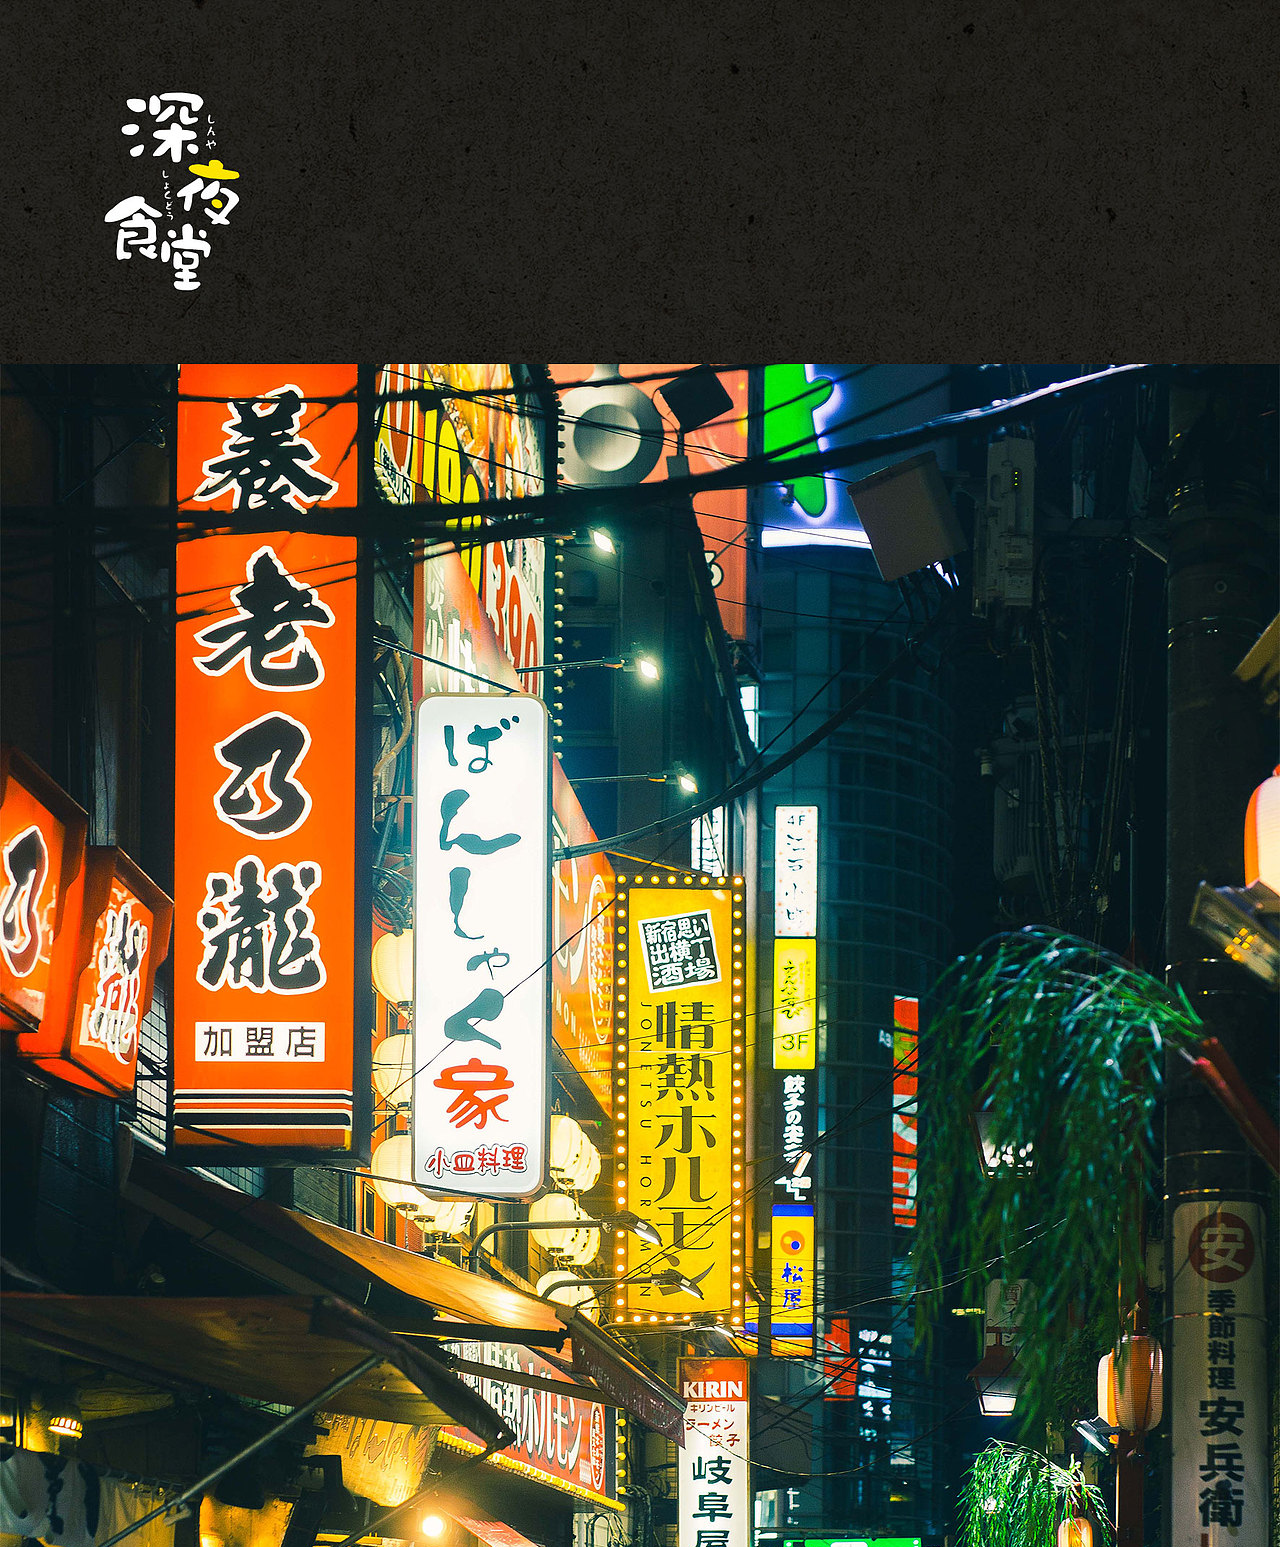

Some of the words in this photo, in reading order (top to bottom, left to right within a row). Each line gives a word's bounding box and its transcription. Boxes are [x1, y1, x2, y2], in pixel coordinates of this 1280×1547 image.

[787, 815, 805, 826] 4F
[433, 715, 522, 1129] ばんしゃく家
[646, 918, 709, 944] 新宿思い
[651, 936, 710, 966] 出横丁
[652, 959, 716, 986] 酒場
[203, 1026, 316, 1057] 加盟店
[782, 1034, 808, 1050] 3F
[640, 1002, 652, 1129] JONETSU
[425, 1143, 529, 1177] 小皿料理
[654, 1001, 717, 1297] 情熱ホルモン
[640, 1155, 652, 1297] HORMON
[1201, 1223, 1245, 1273] 安
[782, 1263, 803, 1309] 松屋
[1207, 1289, 1236, 1391] 季節料理
[683, 1381, 743, 1398] KIRIN
[690, 1404, 735, 1413] キリンビール
[686, 1418, 735, 1431] ラーメン
[709, 1434, 740, 1447] 餃子
[1198, 1397, 1245, 1528] 安兵衛
